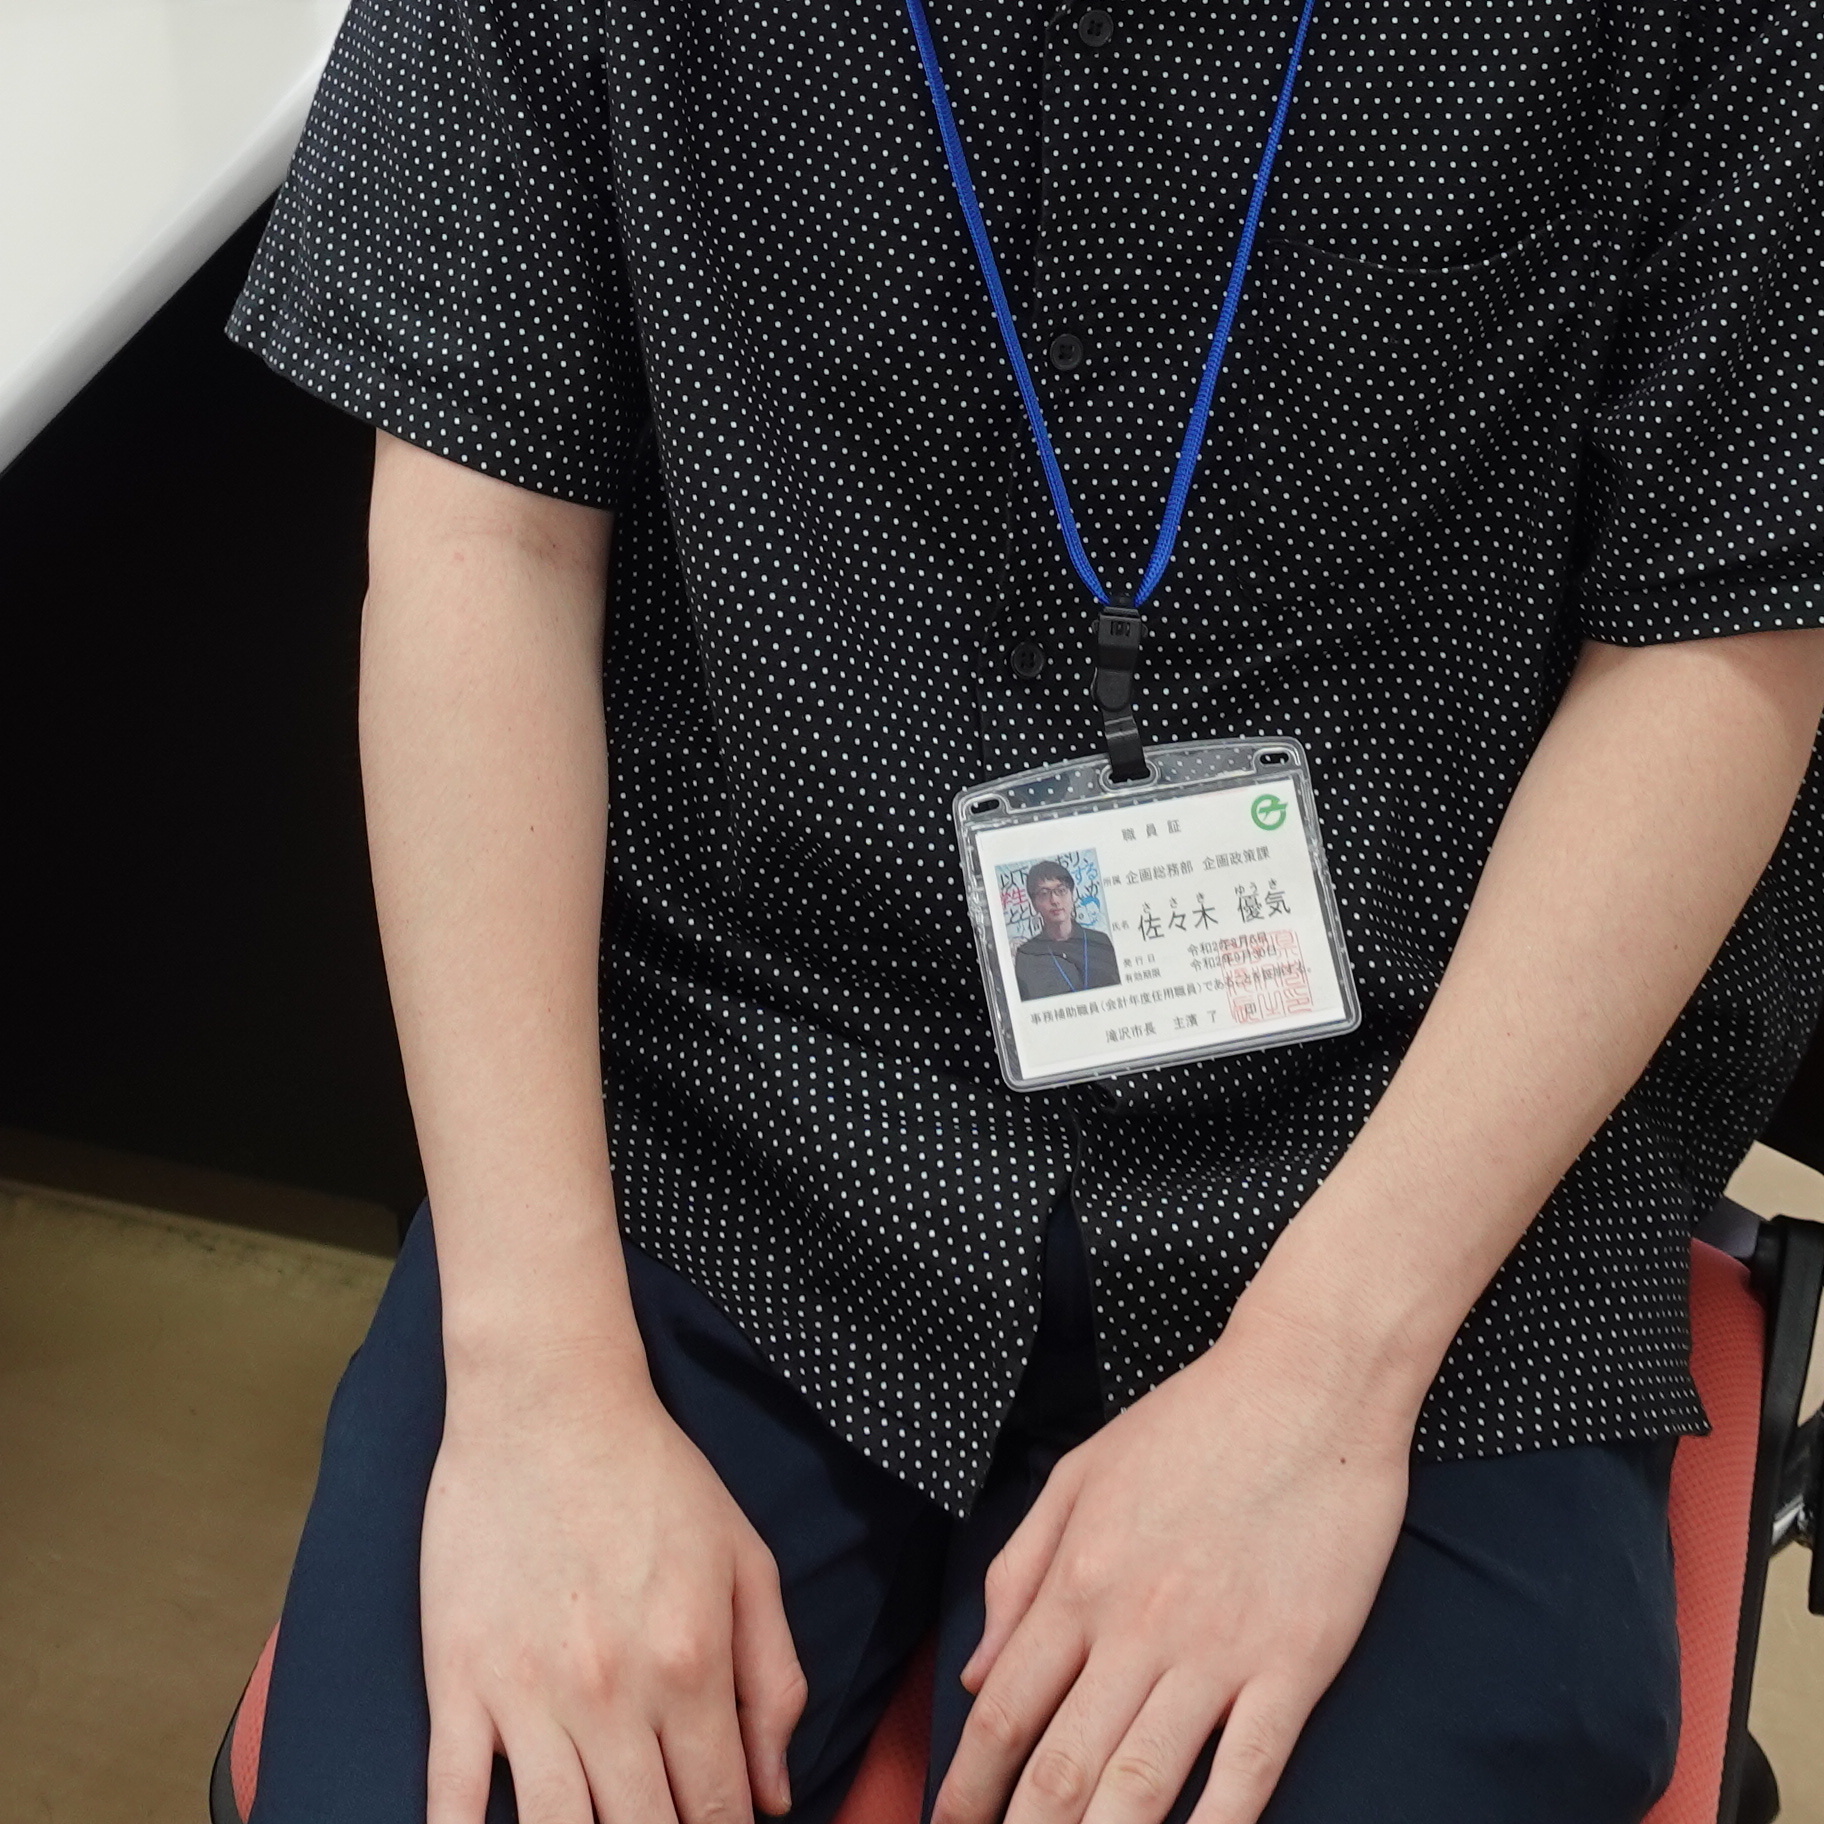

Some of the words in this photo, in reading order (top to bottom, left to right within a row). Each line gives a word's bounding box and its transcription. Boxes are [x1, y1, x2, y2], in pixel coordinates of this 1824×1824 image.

[1121, 819, 1182, 842] 職員証
[1125, 860, 1195, 886] 企画総務部
[1202, 845, 1271, 872] 企画政策課
[1137, 902, 1219, 942] 佐々木
[1236, 889, 1291, 924] 優気
[1105, 1021, 1157, 1044] 滝沢市長
